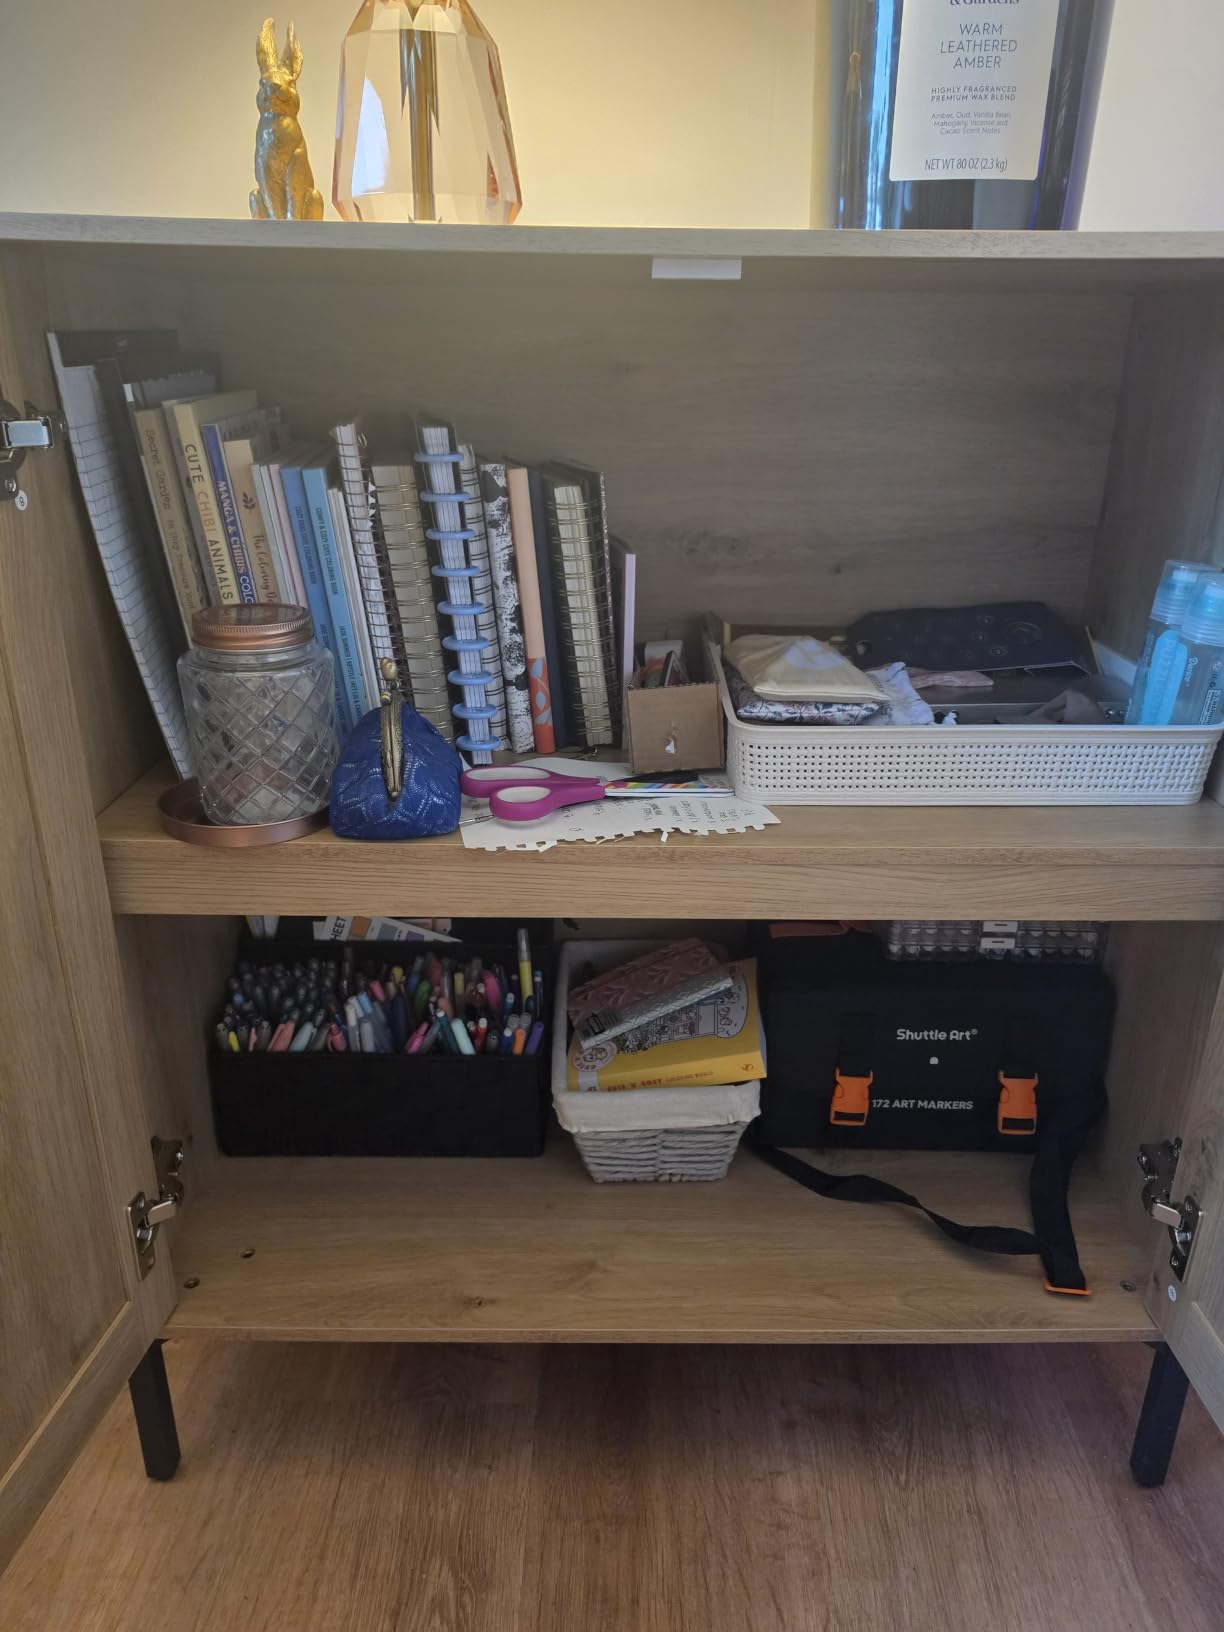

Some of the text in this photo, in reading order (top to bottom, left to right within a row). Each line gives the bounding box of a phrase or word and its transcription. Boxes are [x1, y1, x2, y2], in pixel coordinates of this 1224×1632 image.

[960, 22, 1003, 36] WARM
[940, 39, 1018, 54] LEATHERED
[953, 55, 1002, 69] AMBER
[931, 85, 1017, 94] HIGHLY FRAGRANCED
[990, 93, 1016, 101] BLEND
[924, 158, 941, 171] NET
[942, 158, 956, 171] WT
[956, 158, 968, 170] 80
[968, 158, 980, 170] OZ
[996, 157, 1008, 173] kg)
[217, 479, 235, 523] MANGA
[184, 443, 233, 600] CUTE CHIBI ANIMALS
[226, 523, 238, 533] &
[230, 536, 247, 574] CHIBIS
[896, 1028, 948, 1041] Shuttle
[871, 1099, 973, 1110] 172 ART MARKERS
